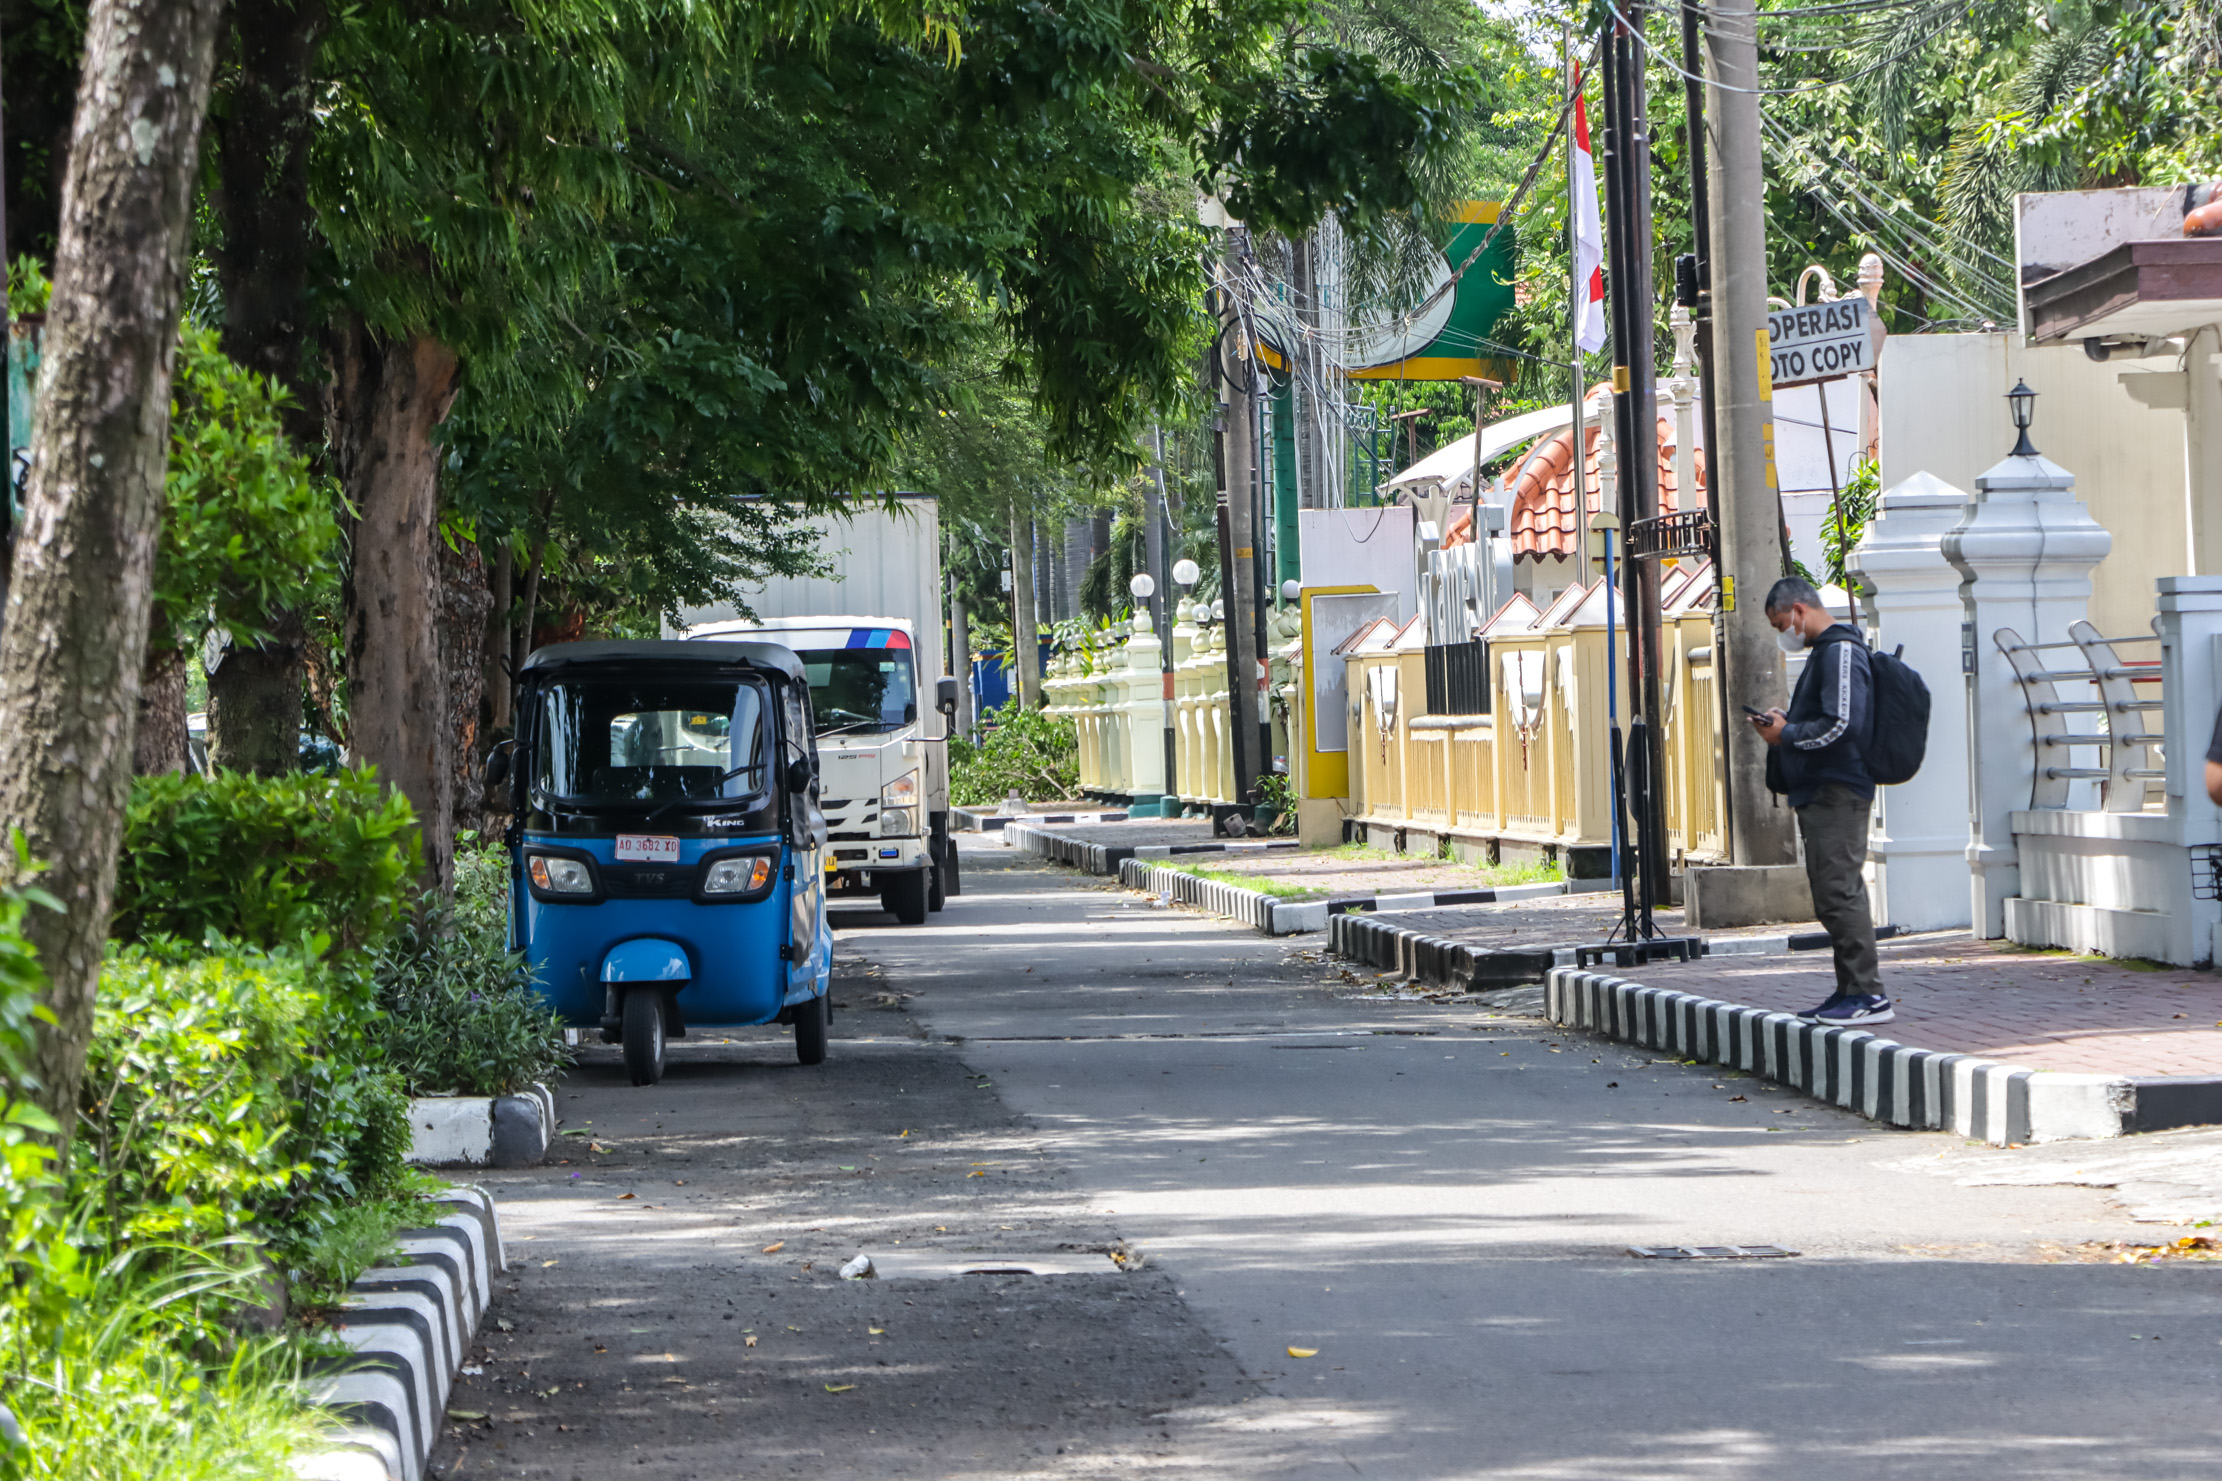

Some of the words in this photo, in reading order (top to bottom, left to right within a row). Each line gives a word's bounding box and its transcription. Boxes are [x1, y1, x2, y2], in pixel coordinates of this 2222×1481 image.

[1812, 341, 1862, 373] COPY
[707, 819, 744, 827] KING
[636, 840, 660, 852] 3682
[634, 872, 665, 885] TVS
